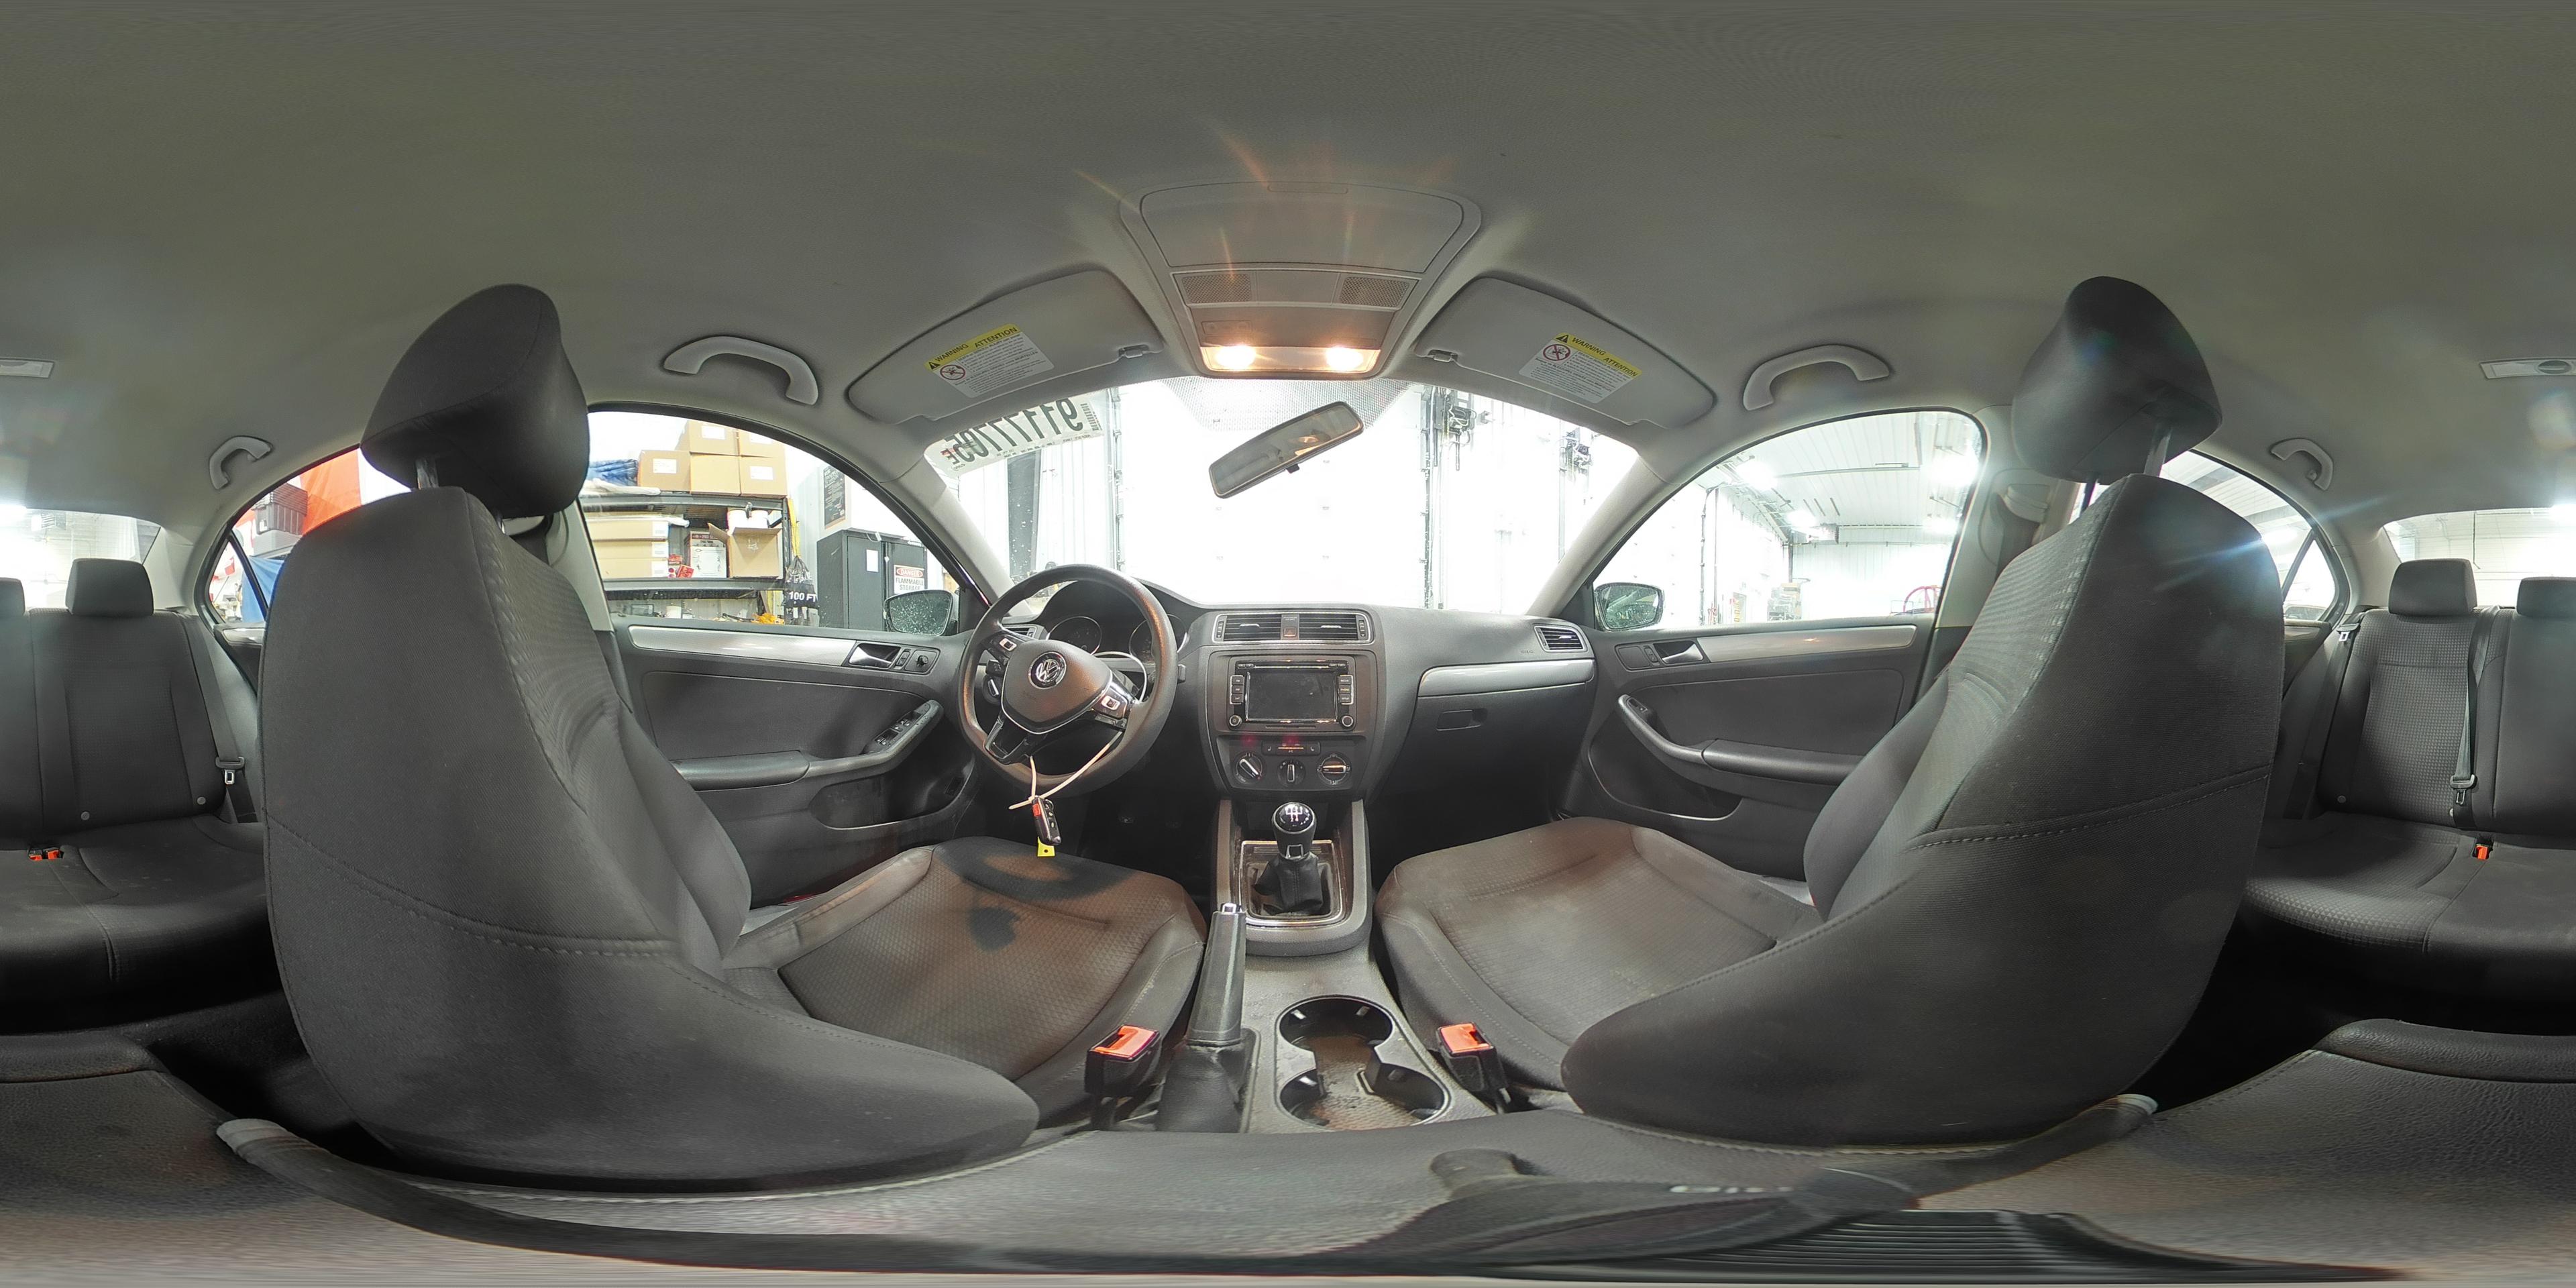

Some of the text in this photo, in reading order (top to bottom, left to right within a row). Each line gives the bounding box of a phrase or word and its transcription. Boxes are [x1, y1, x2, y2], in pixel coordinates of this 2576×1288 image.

[934, 327, 1018, 362] WARNING ATTENTION
[1571, 337, 1607, 356] WARNING
[1603, 357, 1638, 377] ATTENTION
[789, 591, 816, 602] 100 FT
